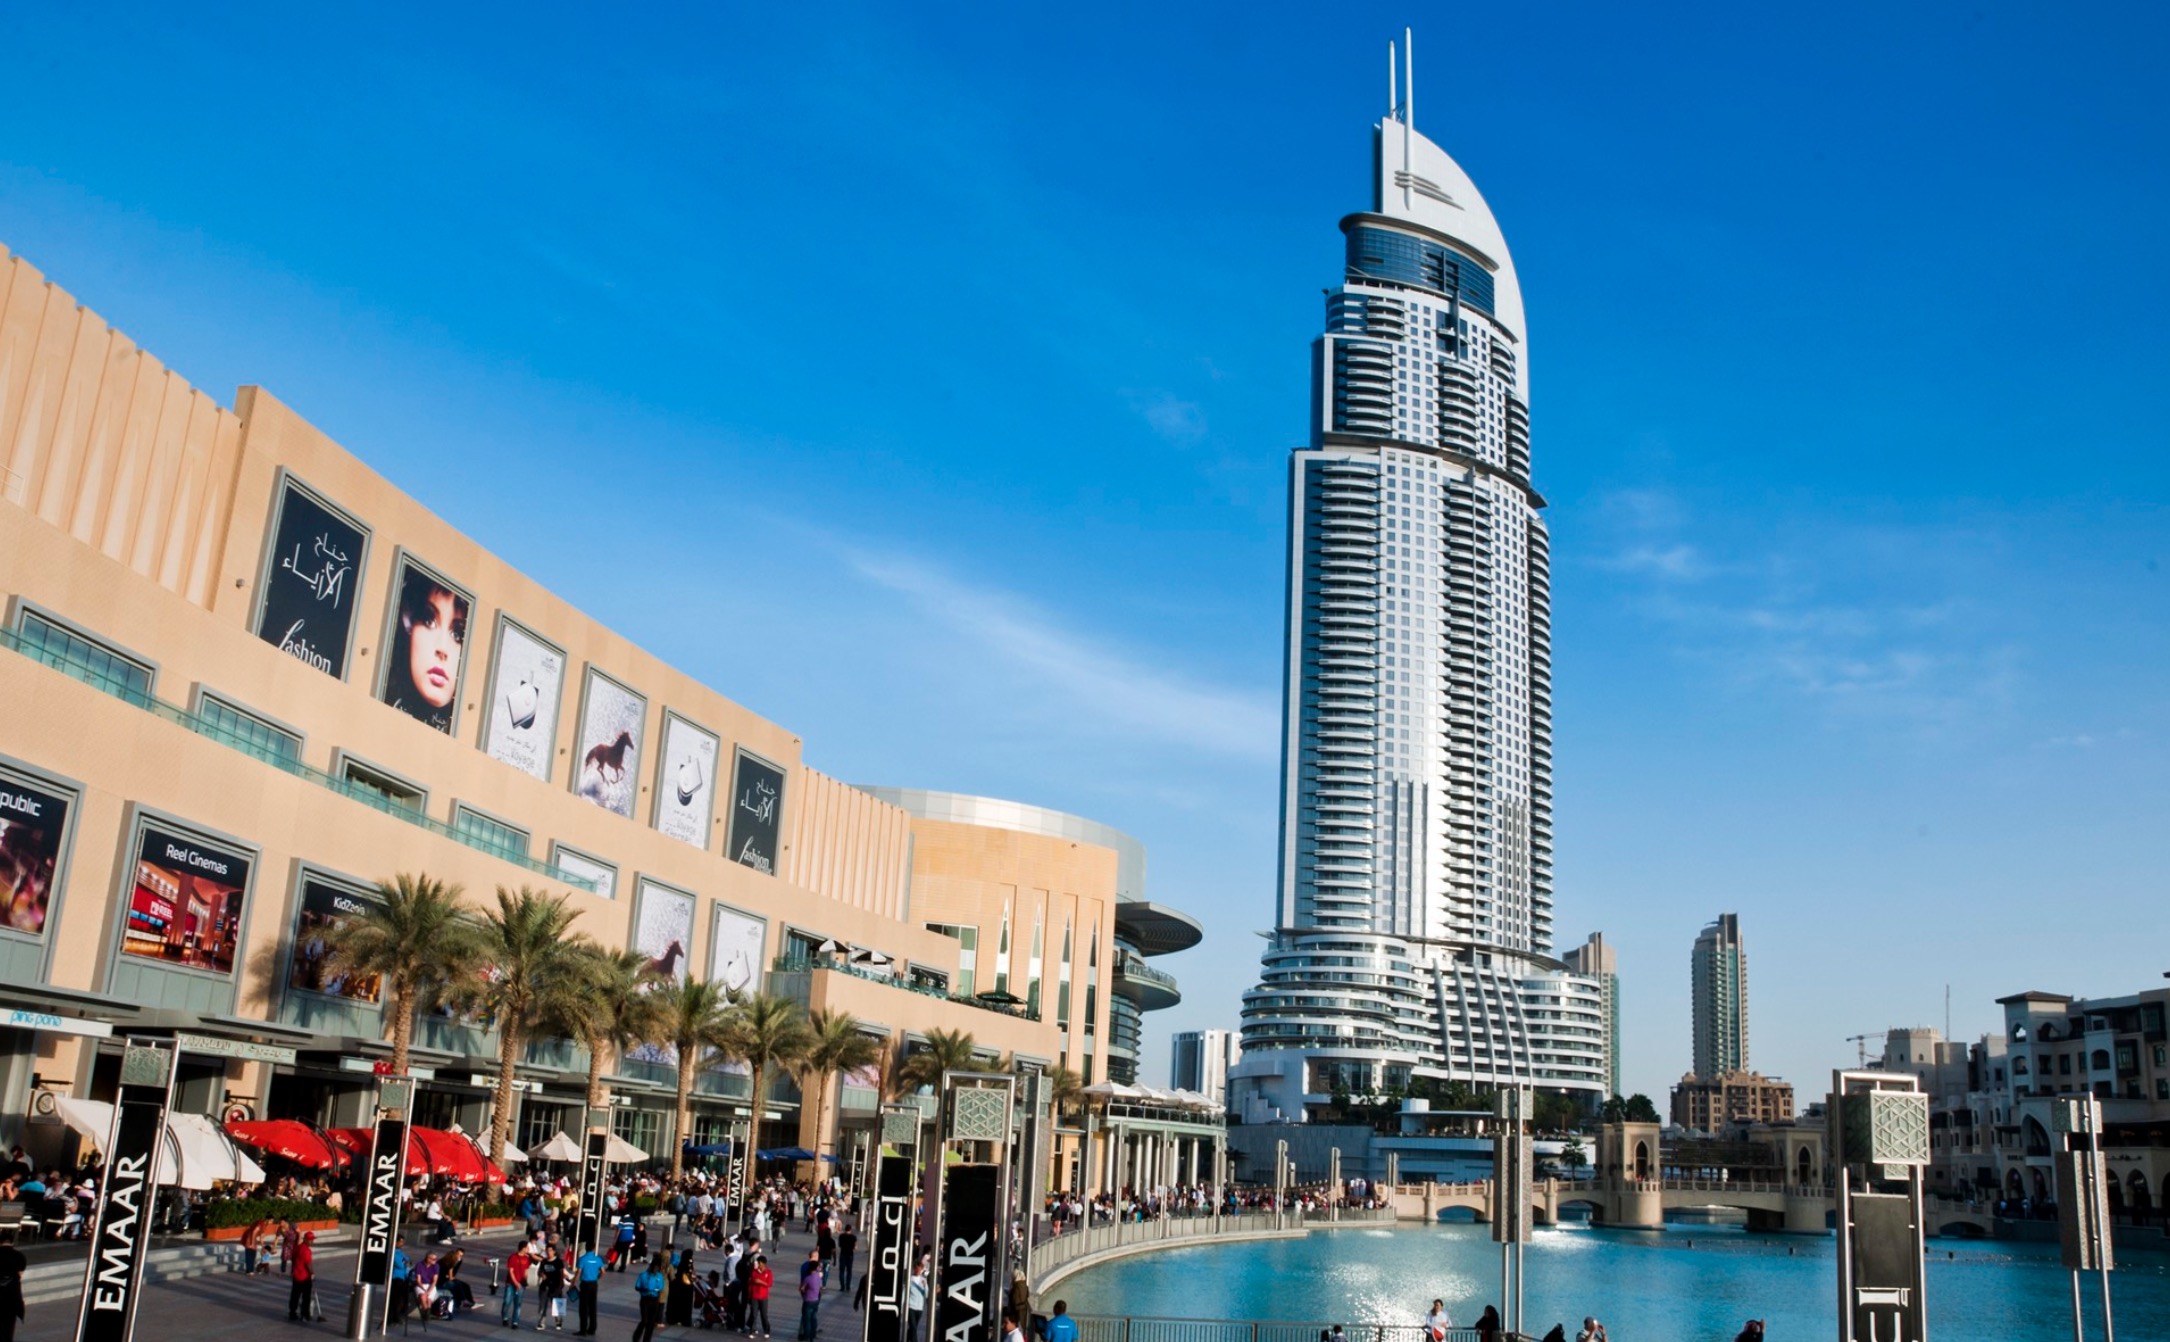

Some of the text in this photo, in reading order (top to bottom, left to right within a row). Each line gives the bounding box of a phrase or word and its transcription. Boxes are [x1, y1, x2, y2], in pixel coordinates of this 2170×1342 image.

[314, 532, 348, 565] جناح
[0, 791, 42, 817] public
[166, 844, 228, 875] Reel Cinemas
[367, 1152, 398, 1253] EMAAR
[729, 1156, 743, 1207] EMAAR
[94, 1152, 148, 1312] EMAAR
